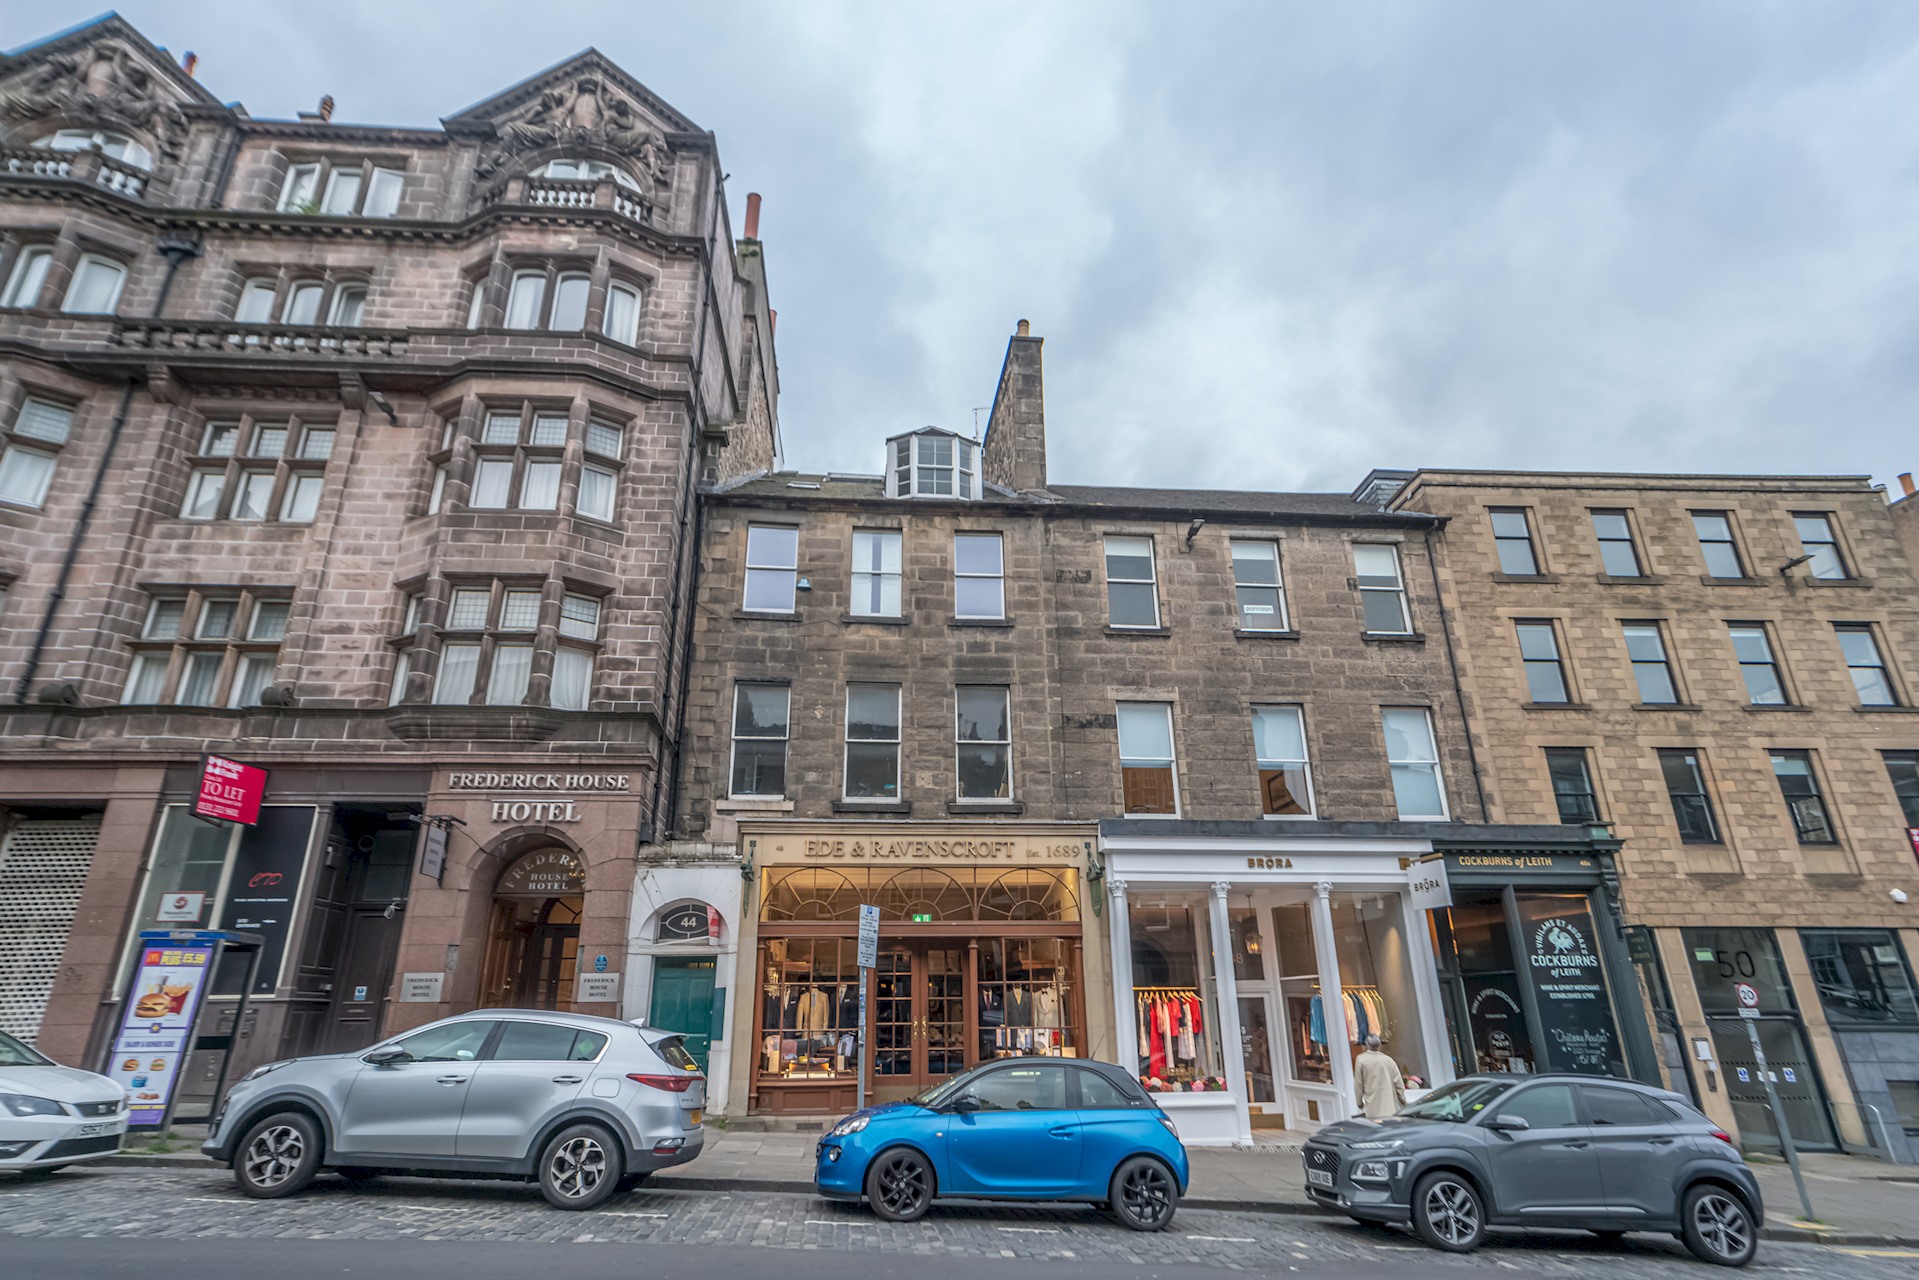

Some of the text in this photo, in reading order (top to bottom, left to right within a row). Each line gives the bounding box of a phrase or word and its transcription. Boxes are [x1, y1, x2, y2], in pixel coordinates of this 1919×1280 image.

[449, 773, 629, 789] FREDERICK HOUSE
[203, 780, 223, 796] TO
[223, 785, 247, 801] LET
[491, 803, 582, 822] HOTEL
[804, 840, 845, 858] EDE
[850, 841, 865, 858] &
[871, 840, 1015, 858] RAVENSCROFT
[1046, 845, 1080, 858] 1689
[1459, 856, 1553, 869] COCKBURNS of LEITH
[531, 873, 568, 881] HOUSE
[528, 882, 568, 890] HOTEL
[680, 916, 697, 927] 44
[1535, 918, 1556, 949] VIGILANS
[1555, 918, 1566, 928] ET
[160, 955, 182, 966] PLUS
[1530, 954, 1598, 968] COCKBURNS
[1716, 950, 1755, 978] 50
[1550, 968, 1582, 979] of LEITH
[1740, 989, 1755, 1000] 20
